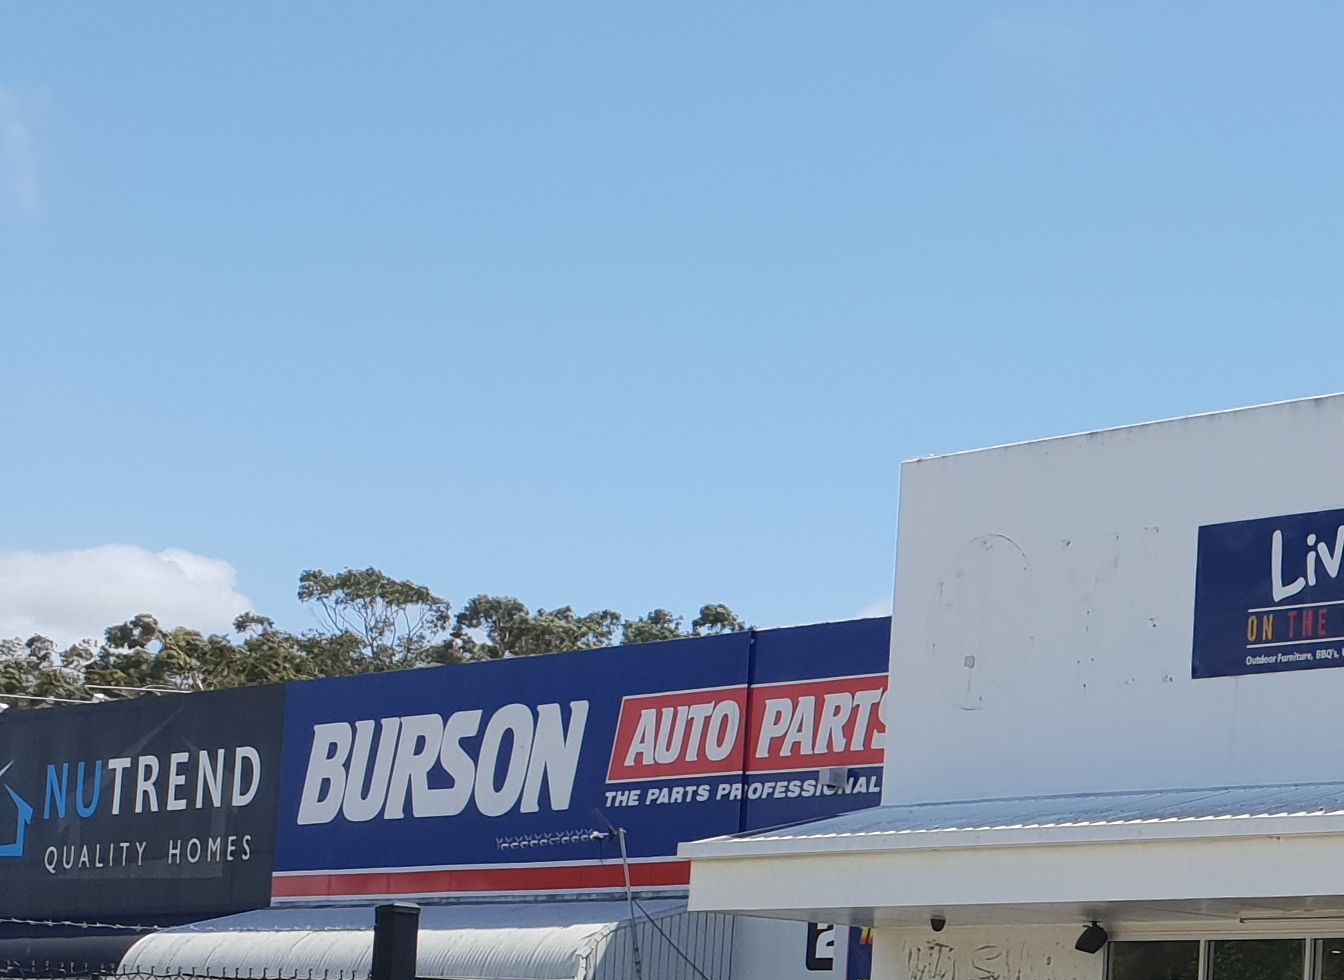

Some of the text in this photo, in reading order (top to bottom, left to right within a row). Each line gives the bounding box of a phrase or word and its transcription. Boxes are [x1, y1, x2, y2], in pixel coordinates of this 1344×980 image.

[1247, 614, 1275, 642] ON
[1287, 608, 1329, 638] THE
[1245, 655, 1276, 666] Outdoor
[623, 699, 741, 767] AUTO
[297, 699, 590, 825] BURSON
[43, 746, 262, 820] NUTREND
[605, 789, 640, 808] THE
[645, 783, 711, 805] PARTS
[44, 834, 252, 875] QUALITY HOMES
